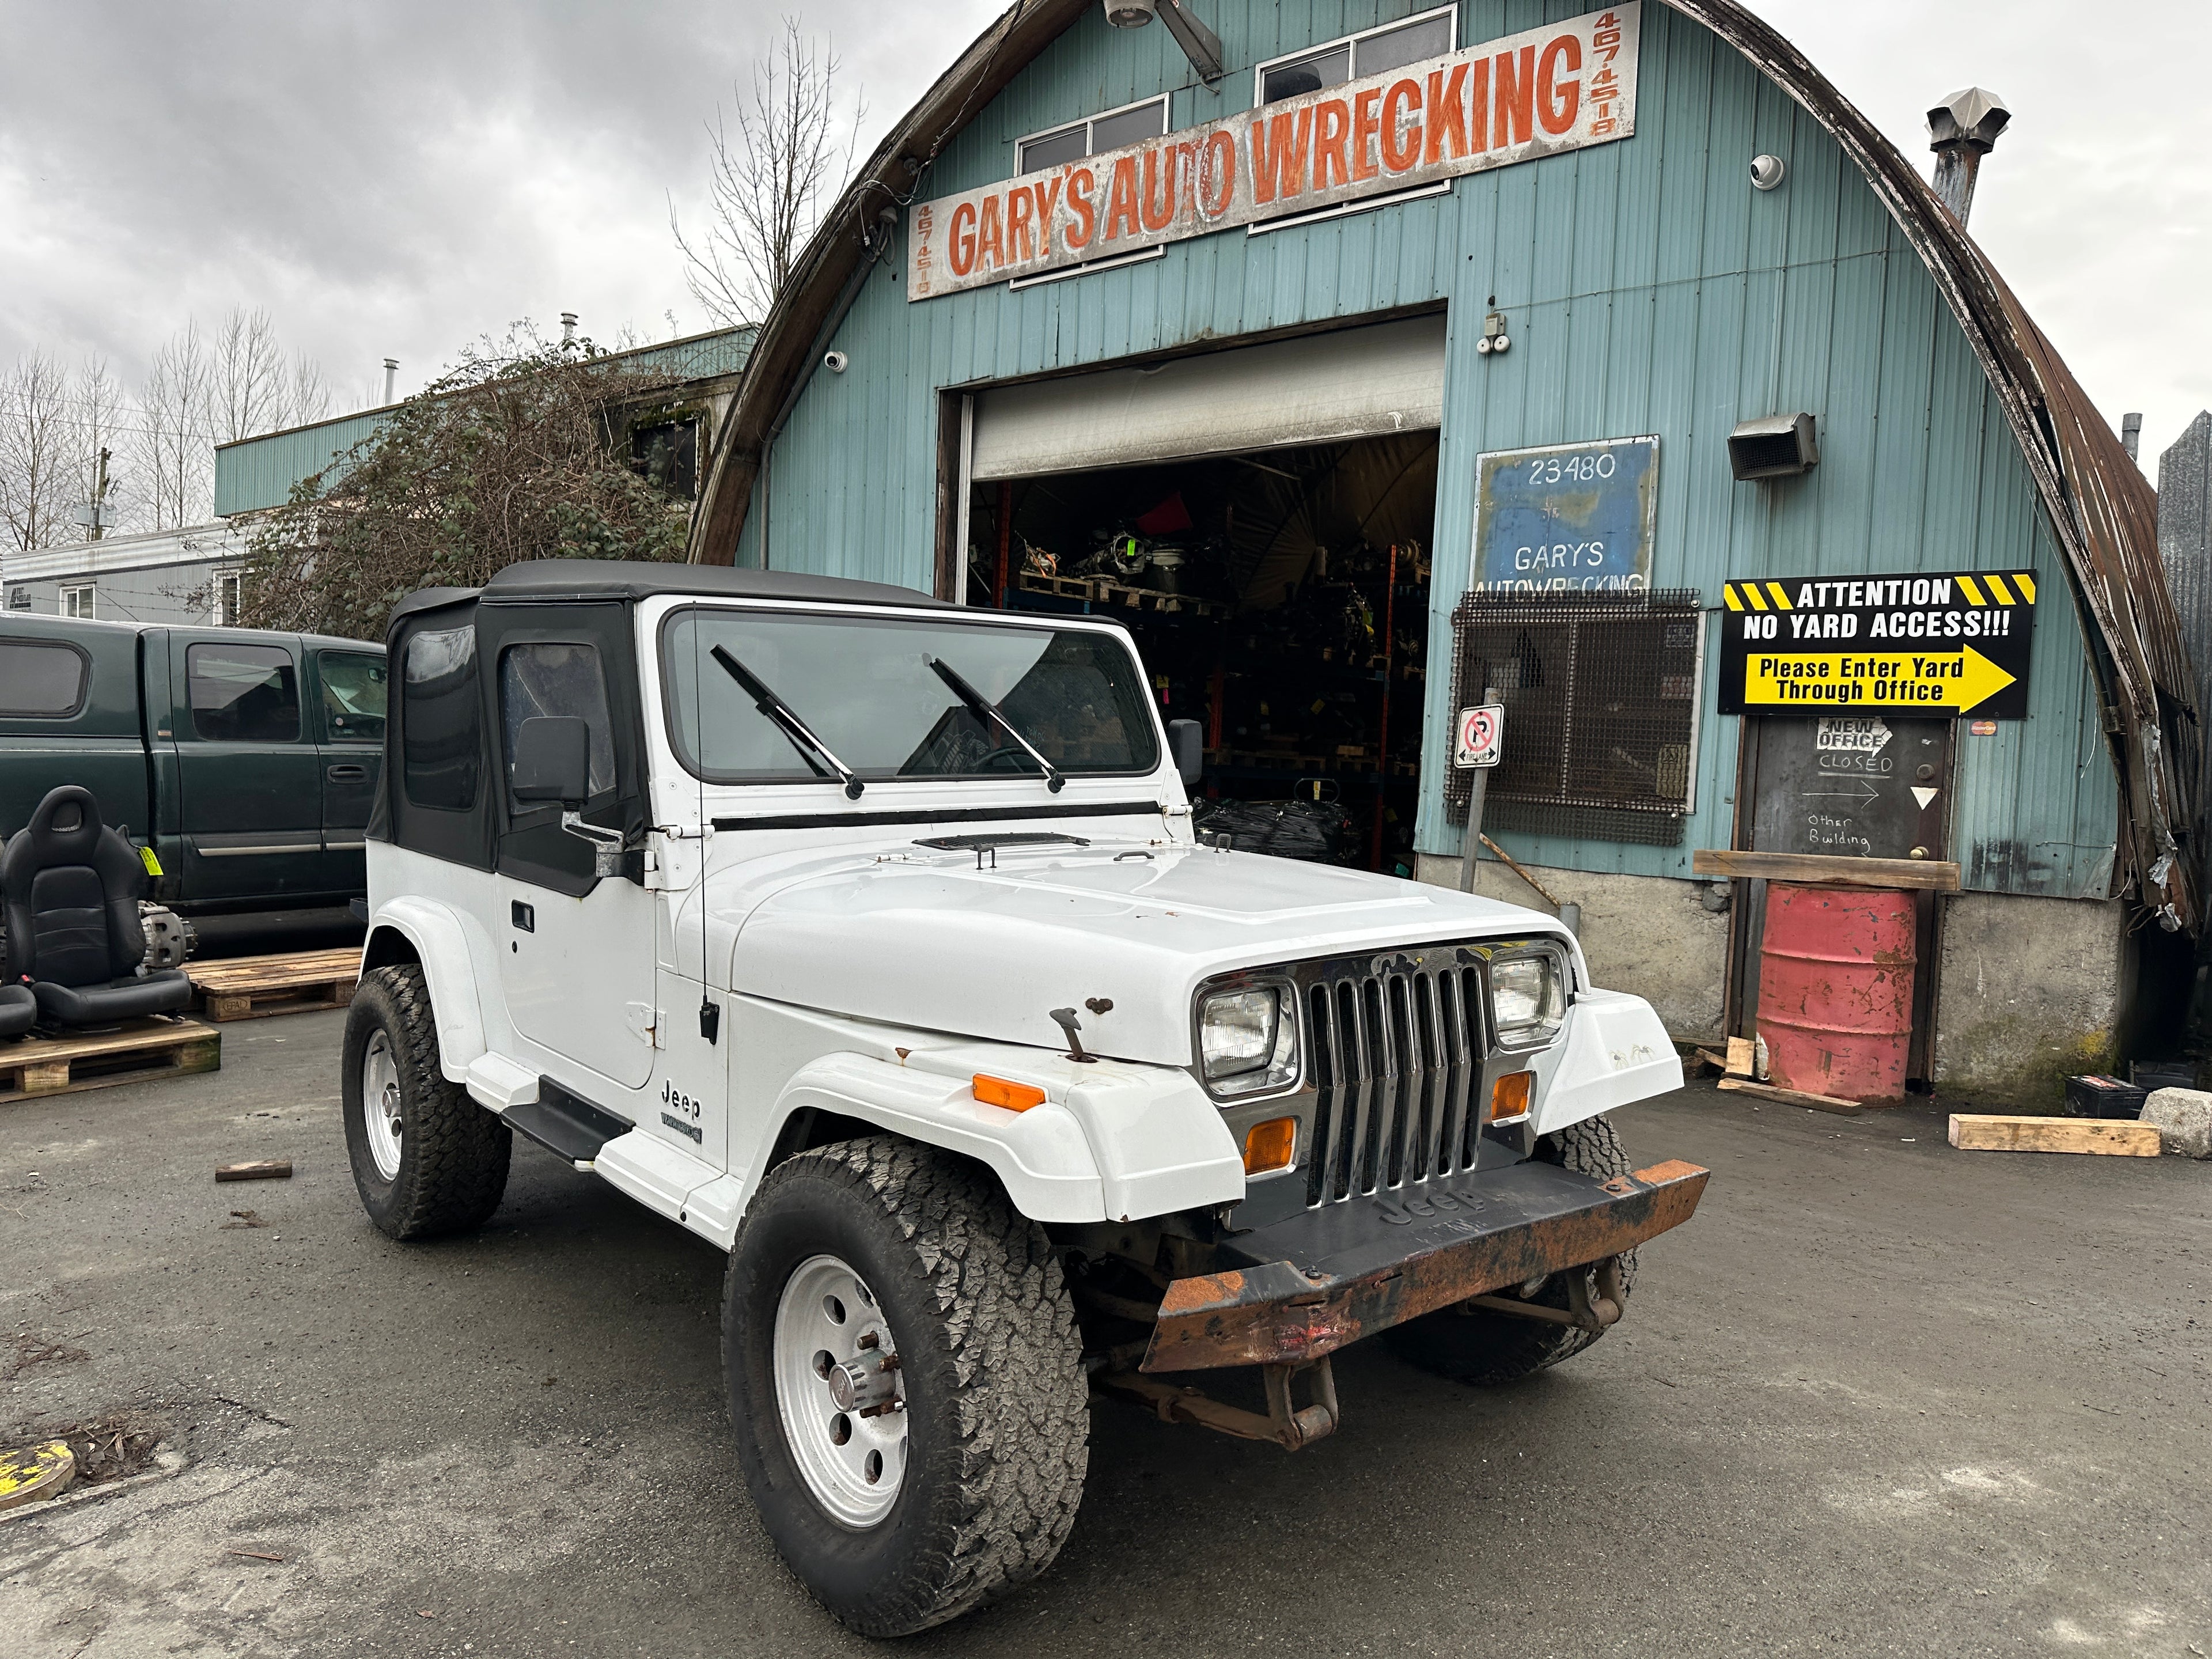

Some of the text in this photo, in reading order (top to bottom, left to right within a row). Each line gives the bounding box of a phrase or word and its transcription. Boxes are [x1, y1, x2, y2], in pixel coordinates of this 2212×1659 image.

[949, 35, 1582, 276] GARY'S AUTO WRECKING
[1529, 453, 1616, 485] 23480
[1515, 541, 1604, 571] GARY'S
[1797, 578, 1952, 608] ATTENTION
[1743, 609, 2011, 639] NO YARD ACCESS!!!
[1760, 657, 1964, 678] Please Enter Yard
[1777, 680, 1944, 703] Through Office
[1819, 734, 1883, 747] OFFICE
[1829, 719, 1873, 733] NEW
[1819, 754, 1893, 772] CLOSED
[1809, 828, 1870, 854] Building
[661, 1079, 700, 1121] Jeep
[1372, 1191, 1486, 1226] Jeep
